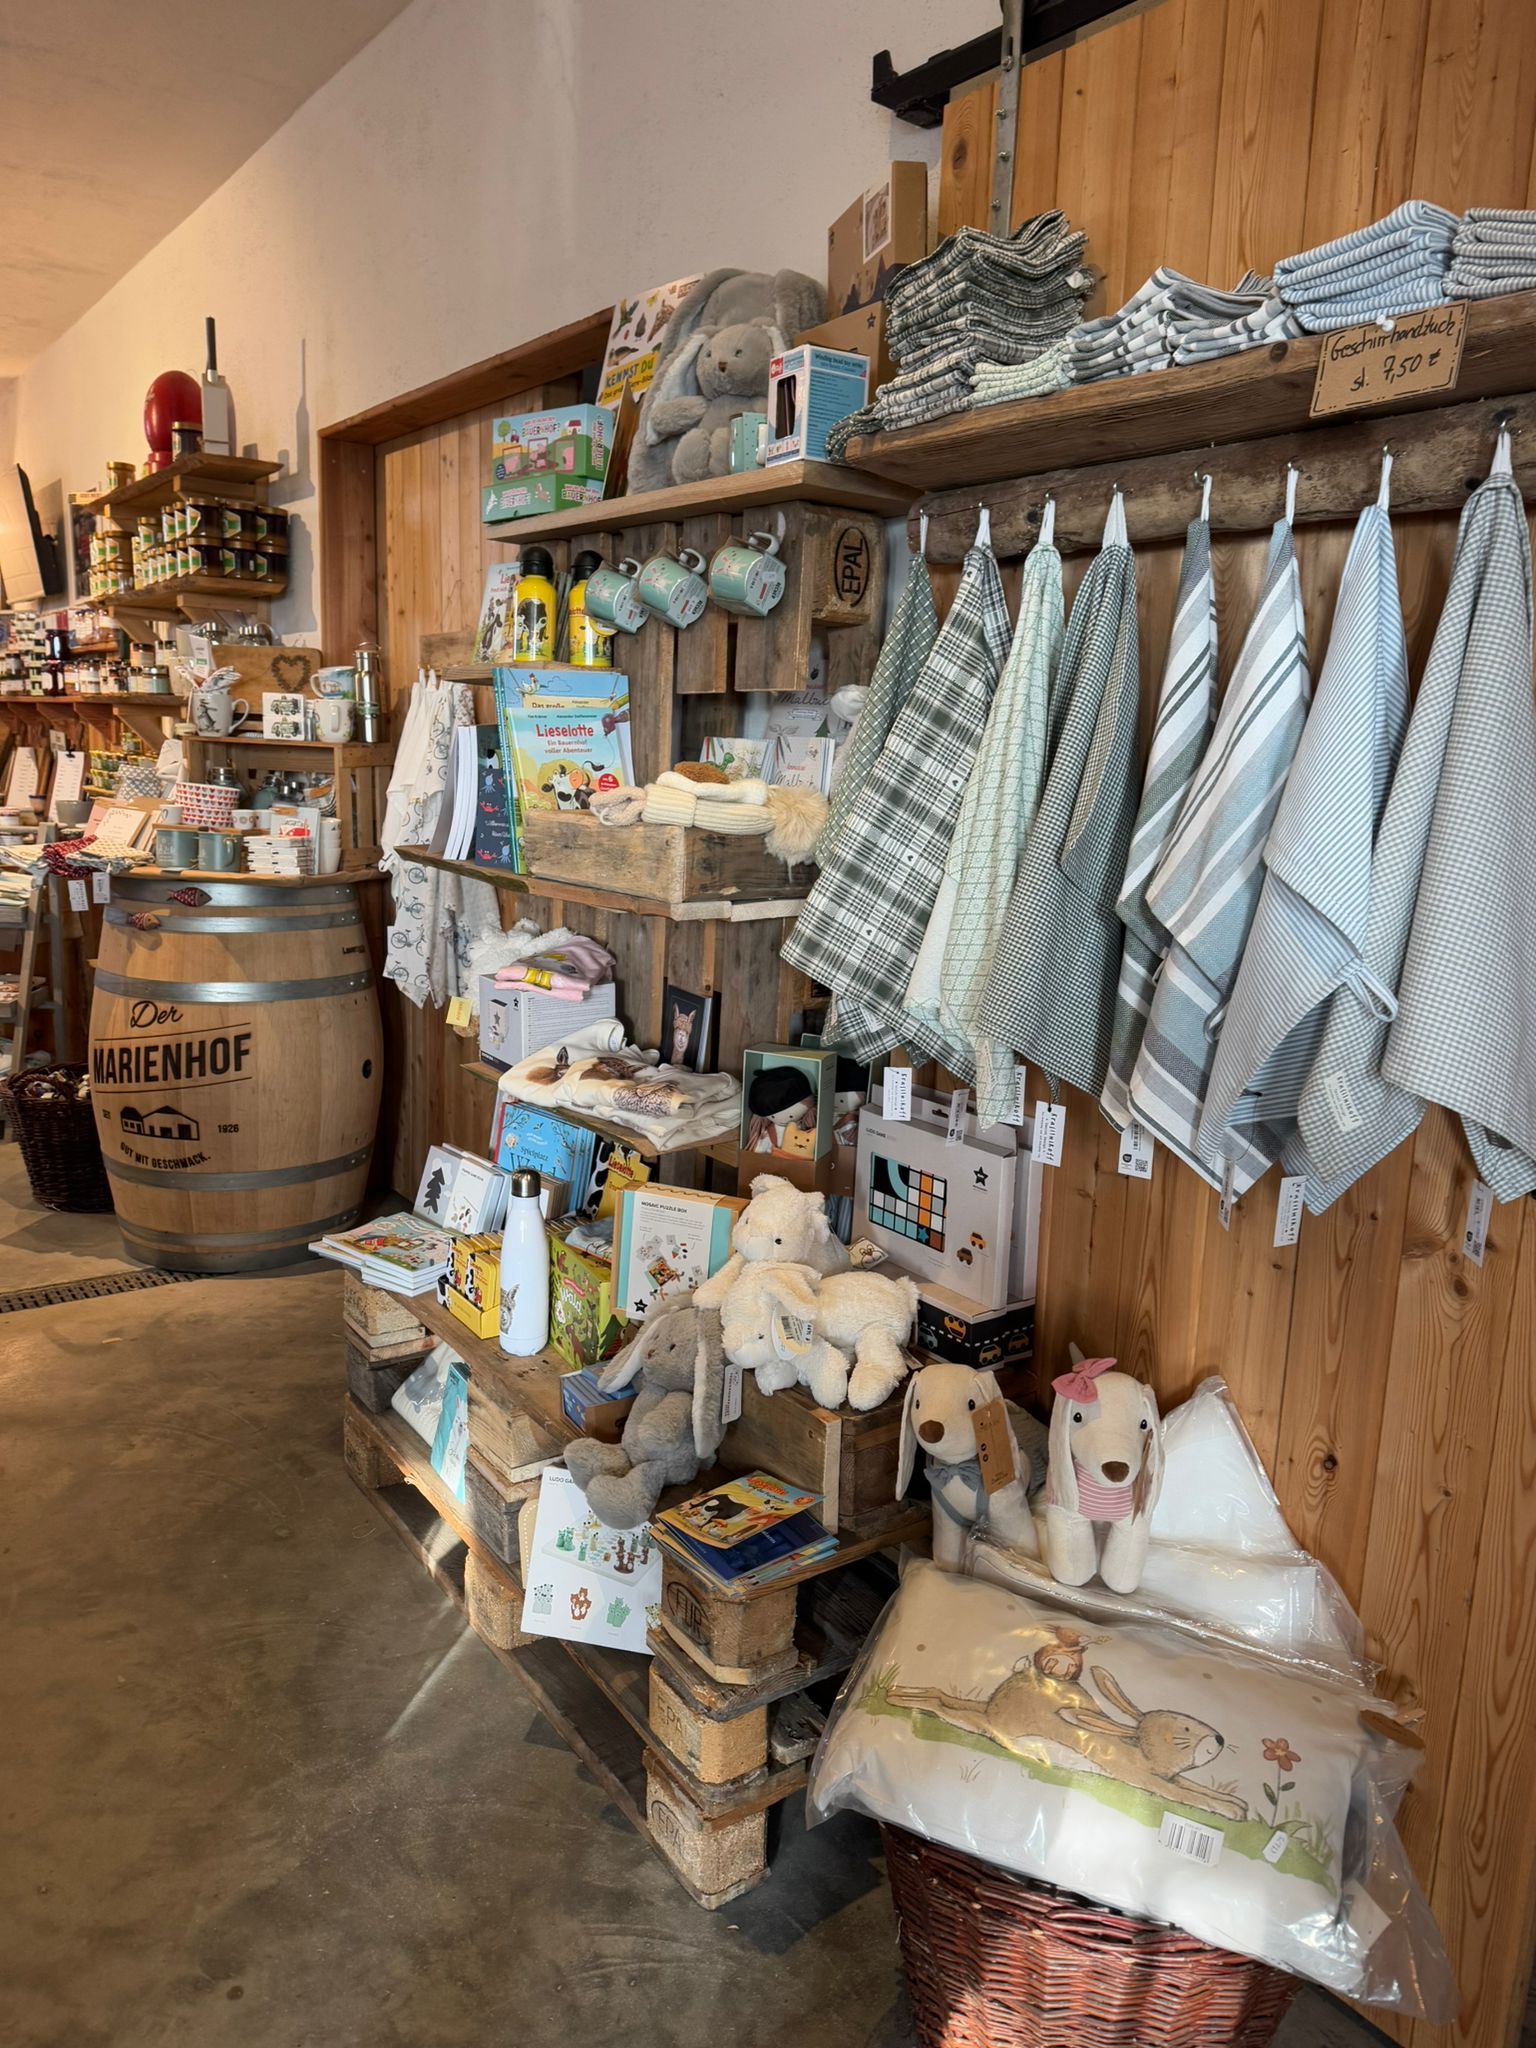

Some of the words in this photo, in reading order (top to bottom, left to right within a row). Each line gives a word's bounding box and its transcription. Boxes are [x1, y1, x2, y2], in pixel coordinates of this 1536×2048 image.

[1330, 310, 1457, 361] Geschirrhandtuch
[1383, 354, 1423, 384] 7,50
[841, 538, 863, 595] EPAL
[535, 724, 594, 737] Lieselotte
[130, 1000, 184, 1029] Der
[93, 1031, 252, 1085] MARIENHOF
[217, 1124, 240, 1134] 1926
[119, 1141, 134, 1158] GUT
[135, 1152, 150, 1166] MIT
[608, 1156, 635, 1180] Lieselotte
[659, 1204, 677, 1212] PUZZLE
[564, 1477, 574, 1485] GA
